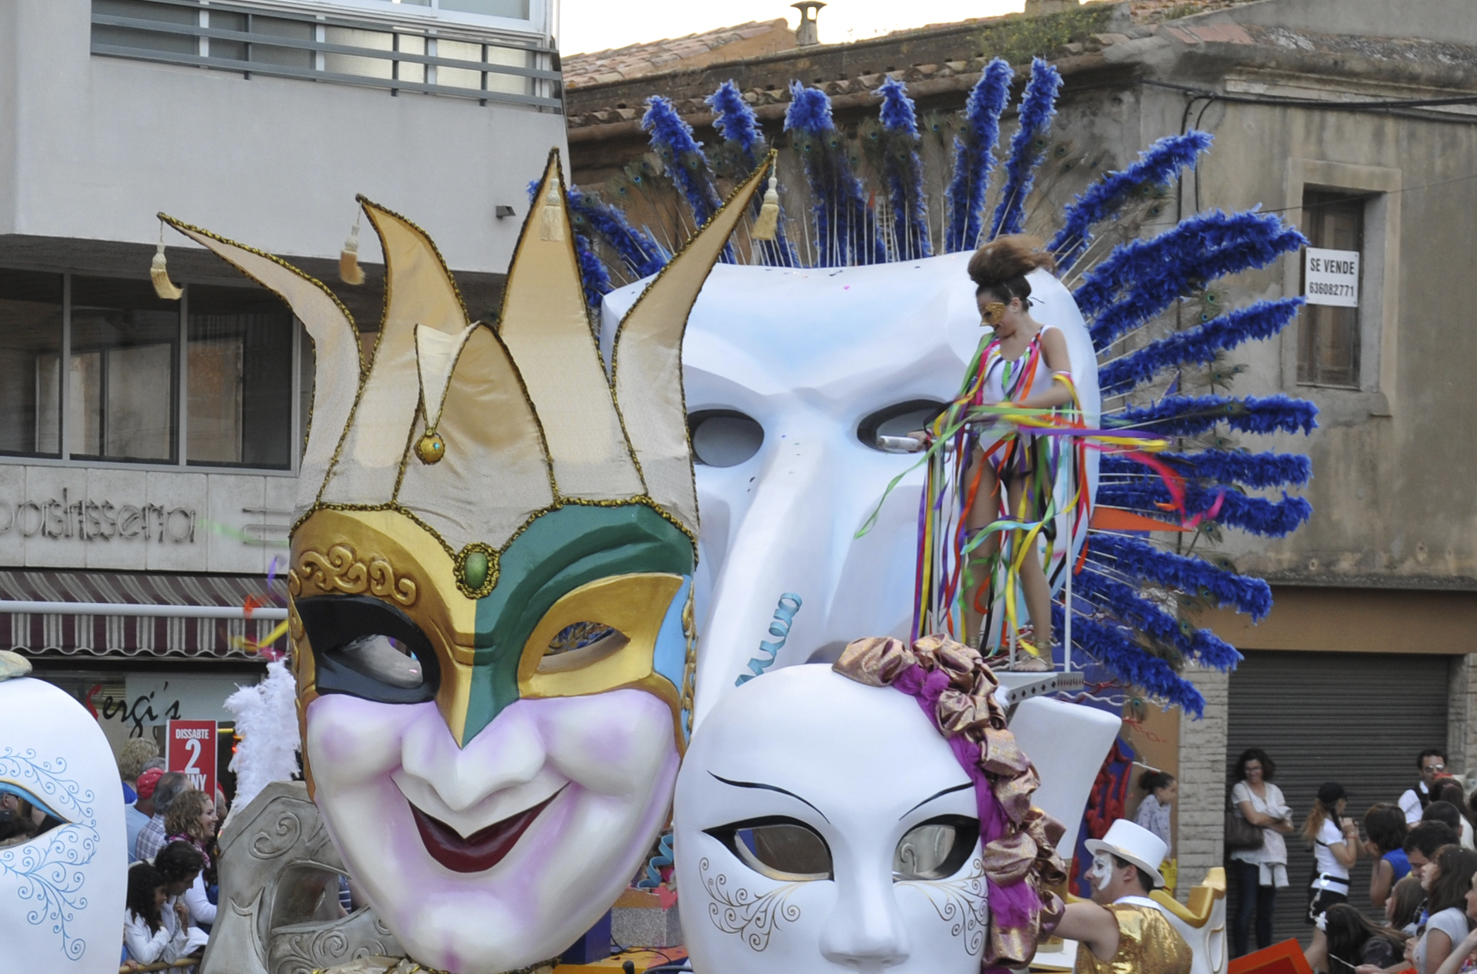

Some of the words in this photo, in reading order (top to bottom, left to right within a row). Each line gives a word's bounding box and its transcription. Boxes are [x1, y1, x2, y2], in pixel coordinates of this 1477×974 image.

[1310, 258, 1321, 272] SE
[1324, 259, 1355, 275] VENDE
[175, 728, 209, 739] DISSABTE
[185, 738, 201, 775] 2
